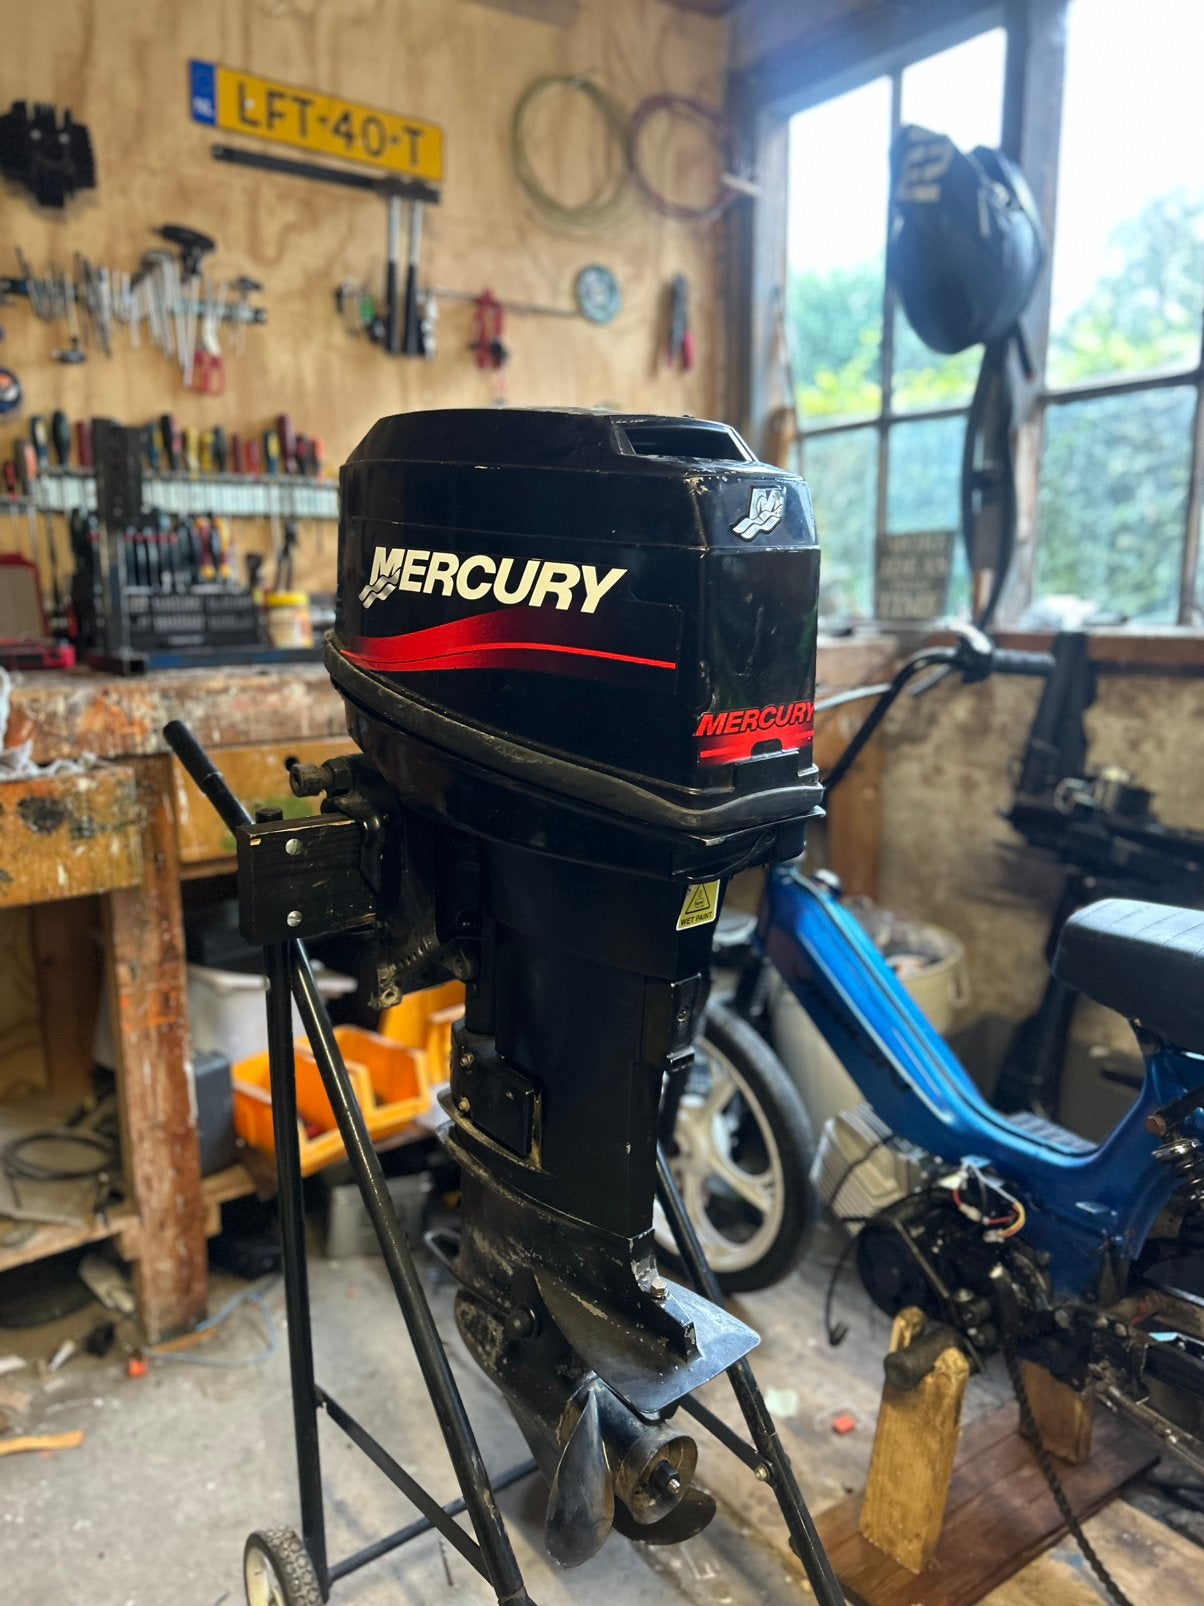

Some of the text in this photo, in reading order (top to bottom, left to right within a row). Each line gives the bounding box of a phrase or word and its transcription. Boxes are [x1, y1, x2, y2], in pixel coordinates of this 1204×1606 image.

[360, 546, 628, 614] MERCURY
[695, 701, 815, 737] MERCURY
[680, 911, 712, 925] WET PAINT
